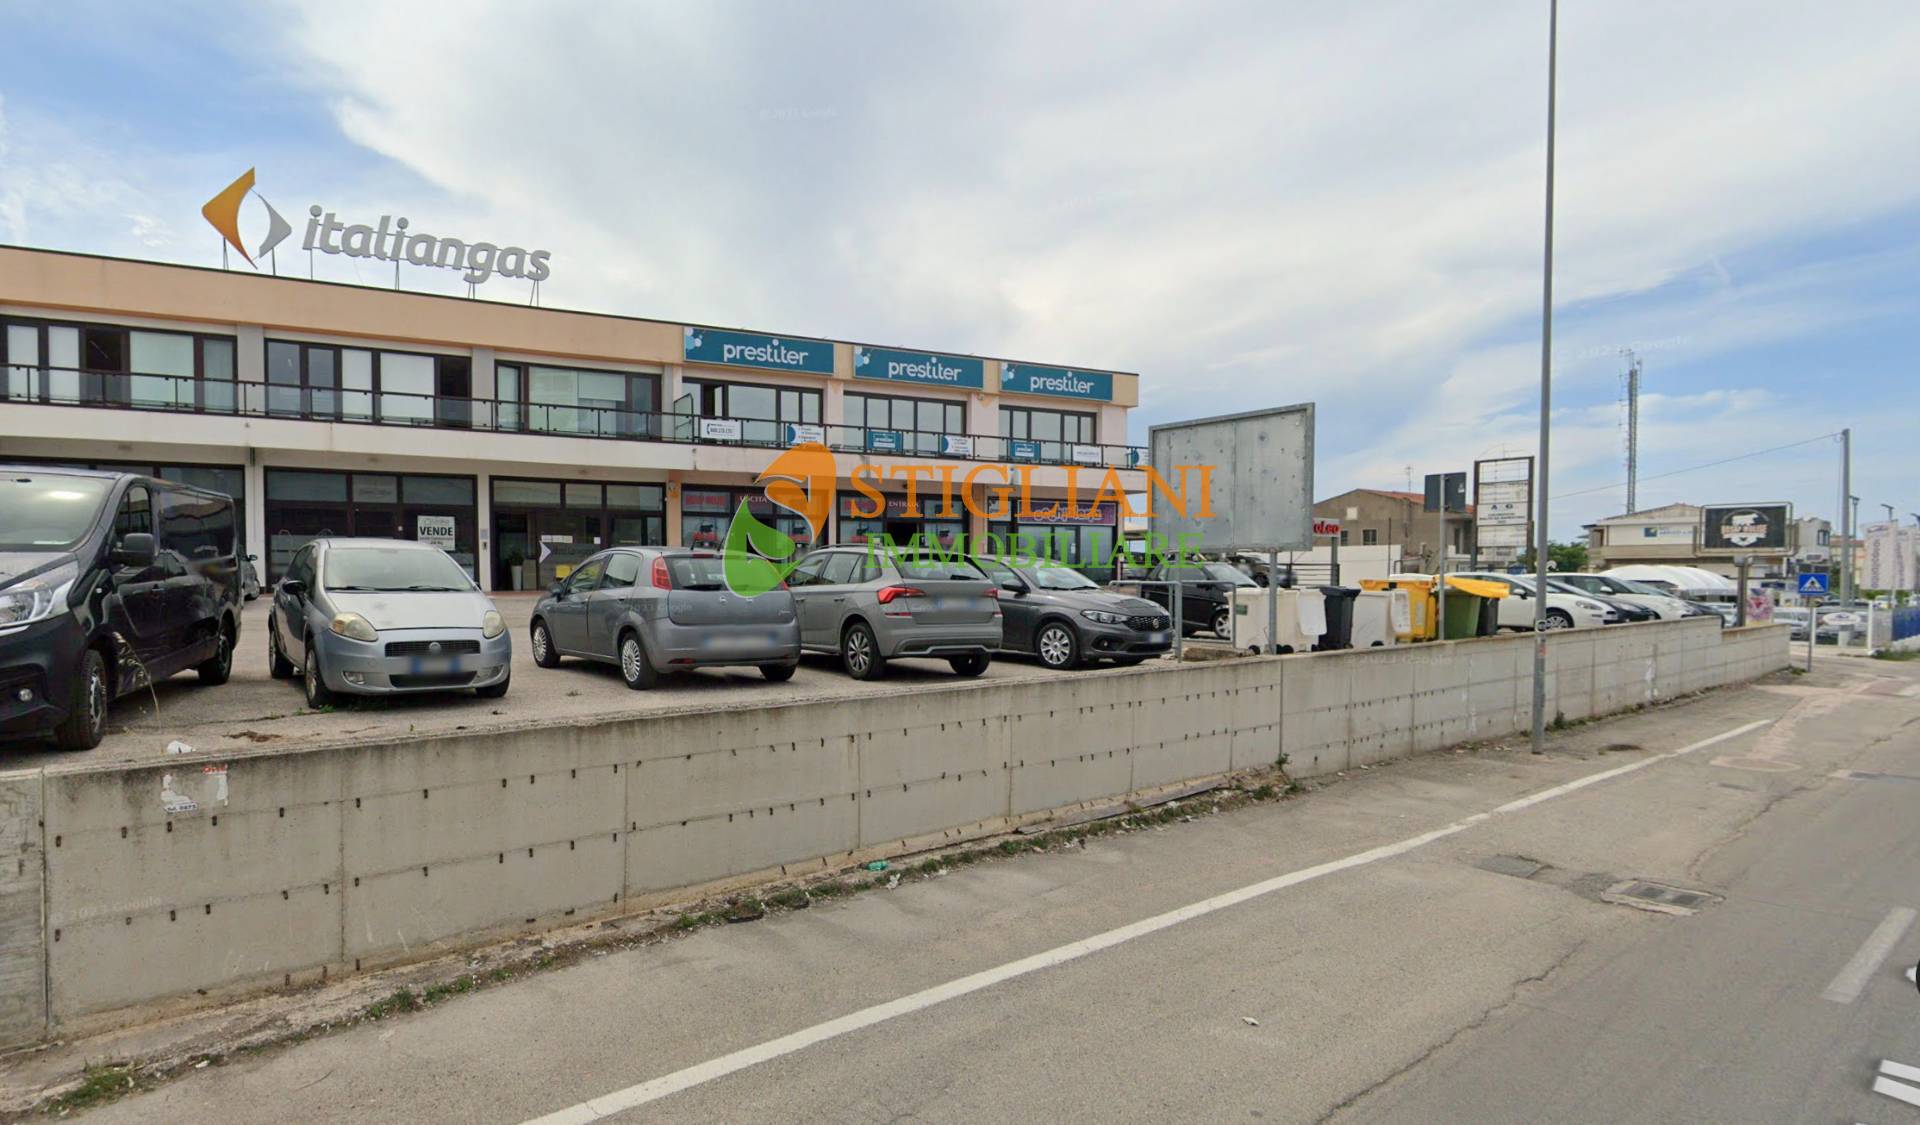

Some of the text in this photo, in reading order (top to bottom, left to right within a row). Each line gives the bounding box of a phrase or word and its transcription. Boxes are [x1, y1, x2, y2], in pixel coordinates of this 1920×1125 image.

[303, 205, 551, 283] italiangas
[723, 338, 809, 365] prestiter
[887, 356, 963, 382] prestiter
[1030, 371, 1095, 394] prestiter
[419, 526, 454, 536] VENDE
